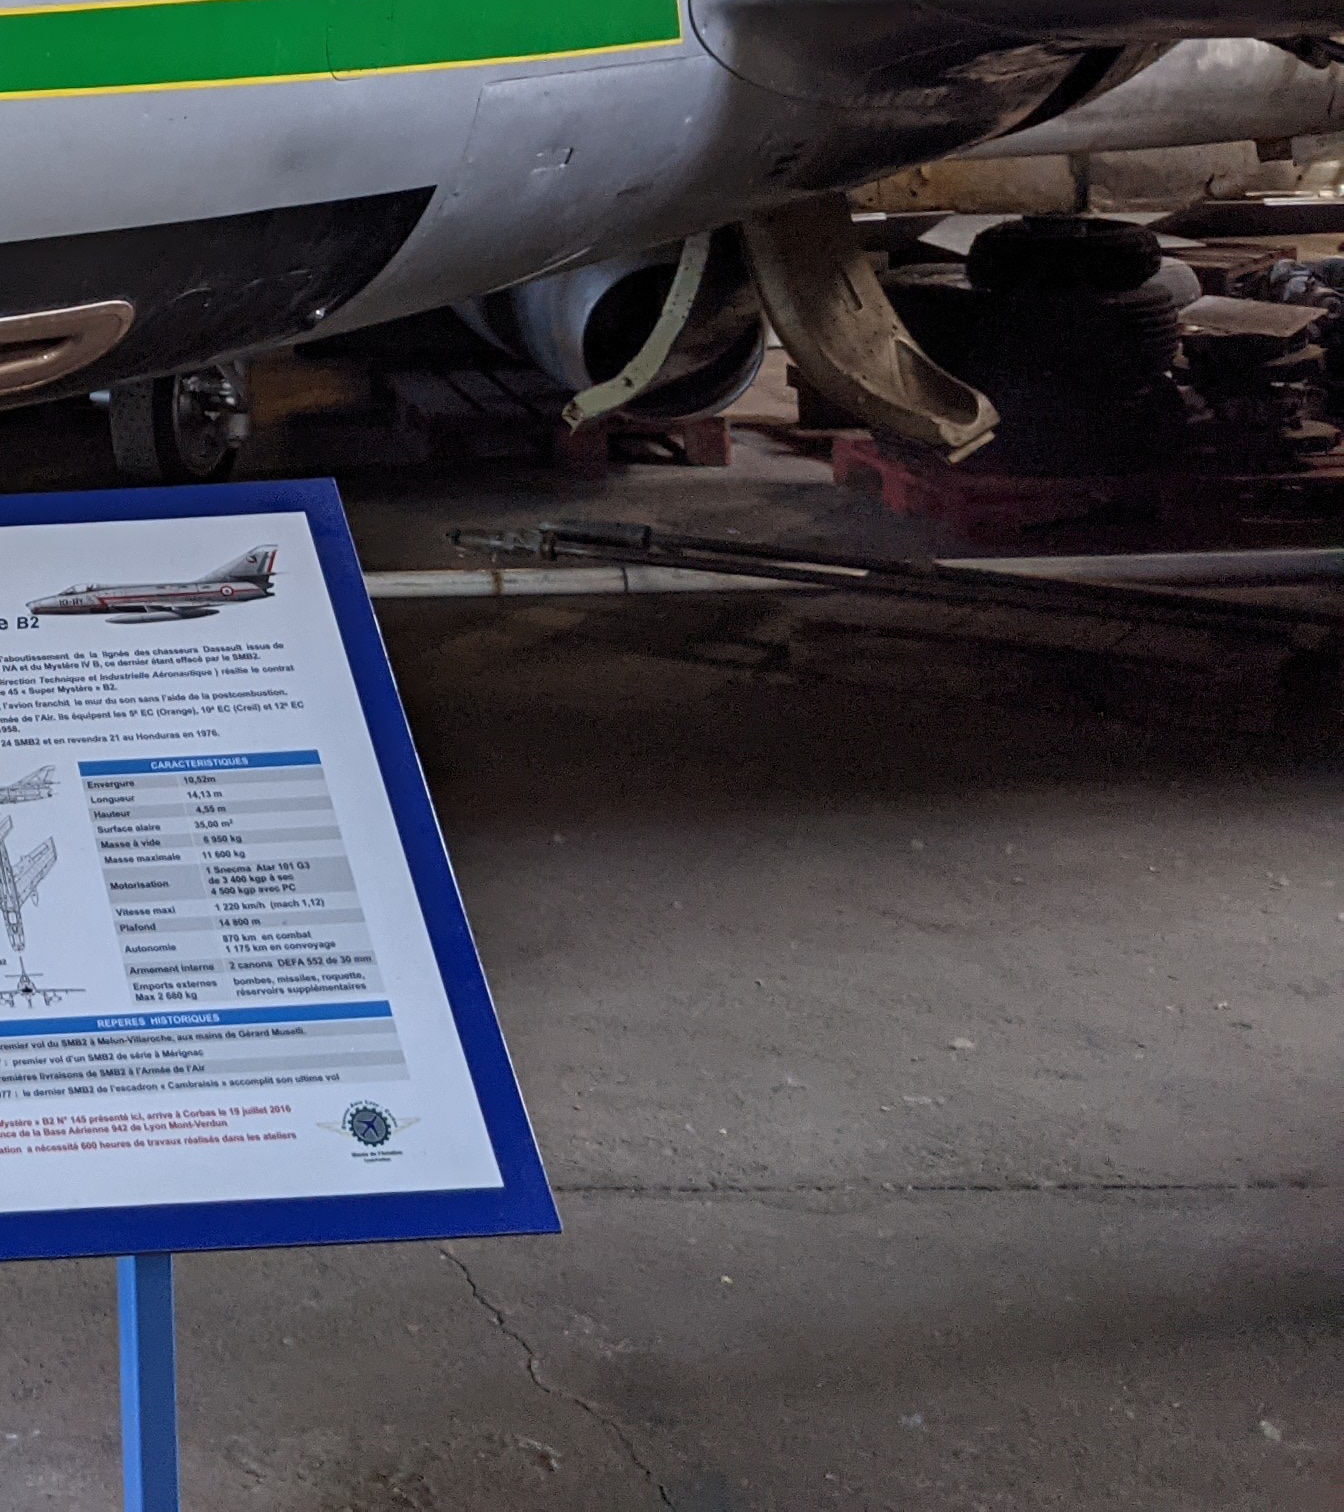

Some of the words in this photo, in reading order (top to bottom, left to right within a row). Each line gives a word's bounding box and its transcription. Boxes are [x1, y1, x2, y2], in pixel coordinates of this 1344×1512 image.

[16, 615, 40, 630] B2
[151, 647, 199, 656] chasseurs
[201, 643, 243, 653] Dassault
[38, 675, 86, 684] Technique
[261, 664, 295, 673] contrat
[27, 686, 55, 696] Super
[34, 698, 71, 708] franchit
[70, 710, 112, 721] équipent
[66, 734, 108, 744] revendra
[135, 731, 181, 740] Honduras
[150, 756, 249, 769] CARACTERISTIQUES
[86, 779, 135, 789] Envergure
[89, 794, 135, 804] Longueur
[92, 810, 130, 819] Hauteur
[96, 824, 133, 834] Surface
[134, 823, 161, 832] alaire
[99, 840, 131, 849] Masse
[103, 855, 135, 864] Masse
[135, 852, 181, 863] maximale
[212, 865, 252, 874] Snecma
[109, 880, 170, 890] Motorisation
[269, 898, 300, 910] (mach
[114, 907, 151, 917] Vitesse
[118, 922, 156, 932] Plafond
[274, 930, 312, 940] combat
[124, 942, 177, 953] Autonomie
[283, 940, 336, 951] convoyage
[129, 964, 180, 975] Armement
[180, 963, 215, 972] interne
[237, 960, 273, 970] canons
[132, 981, 174, 992] Emports
[175, 979, 218, 989] externes
[232, 975, 275, 986] bombes,
[96, 1016, 146, 1028] REPERES
[149, 1012, 220, 1025] HISTORIQUES
[194, 1032, 223, 1040] mains
[237, 1028, 270, 1038] Gérard
[11, 1056, 47, 1067] premier
[129, 1050, 152, 1060] série
[38, 1071, 84, 1080] livraisons
[228, 1075, 274, 1087] accomplit
[294, 1074, 324, 1083] ultime
[182, 1108, 217, 1118] Corbas
[167, 1118, 228, 1129] Mont-Verdun
[98, 1140, 132, 1149] heures
[146, 1137, 182, 1147] travaux
[262, 1131, 297, 1141] ateliers
